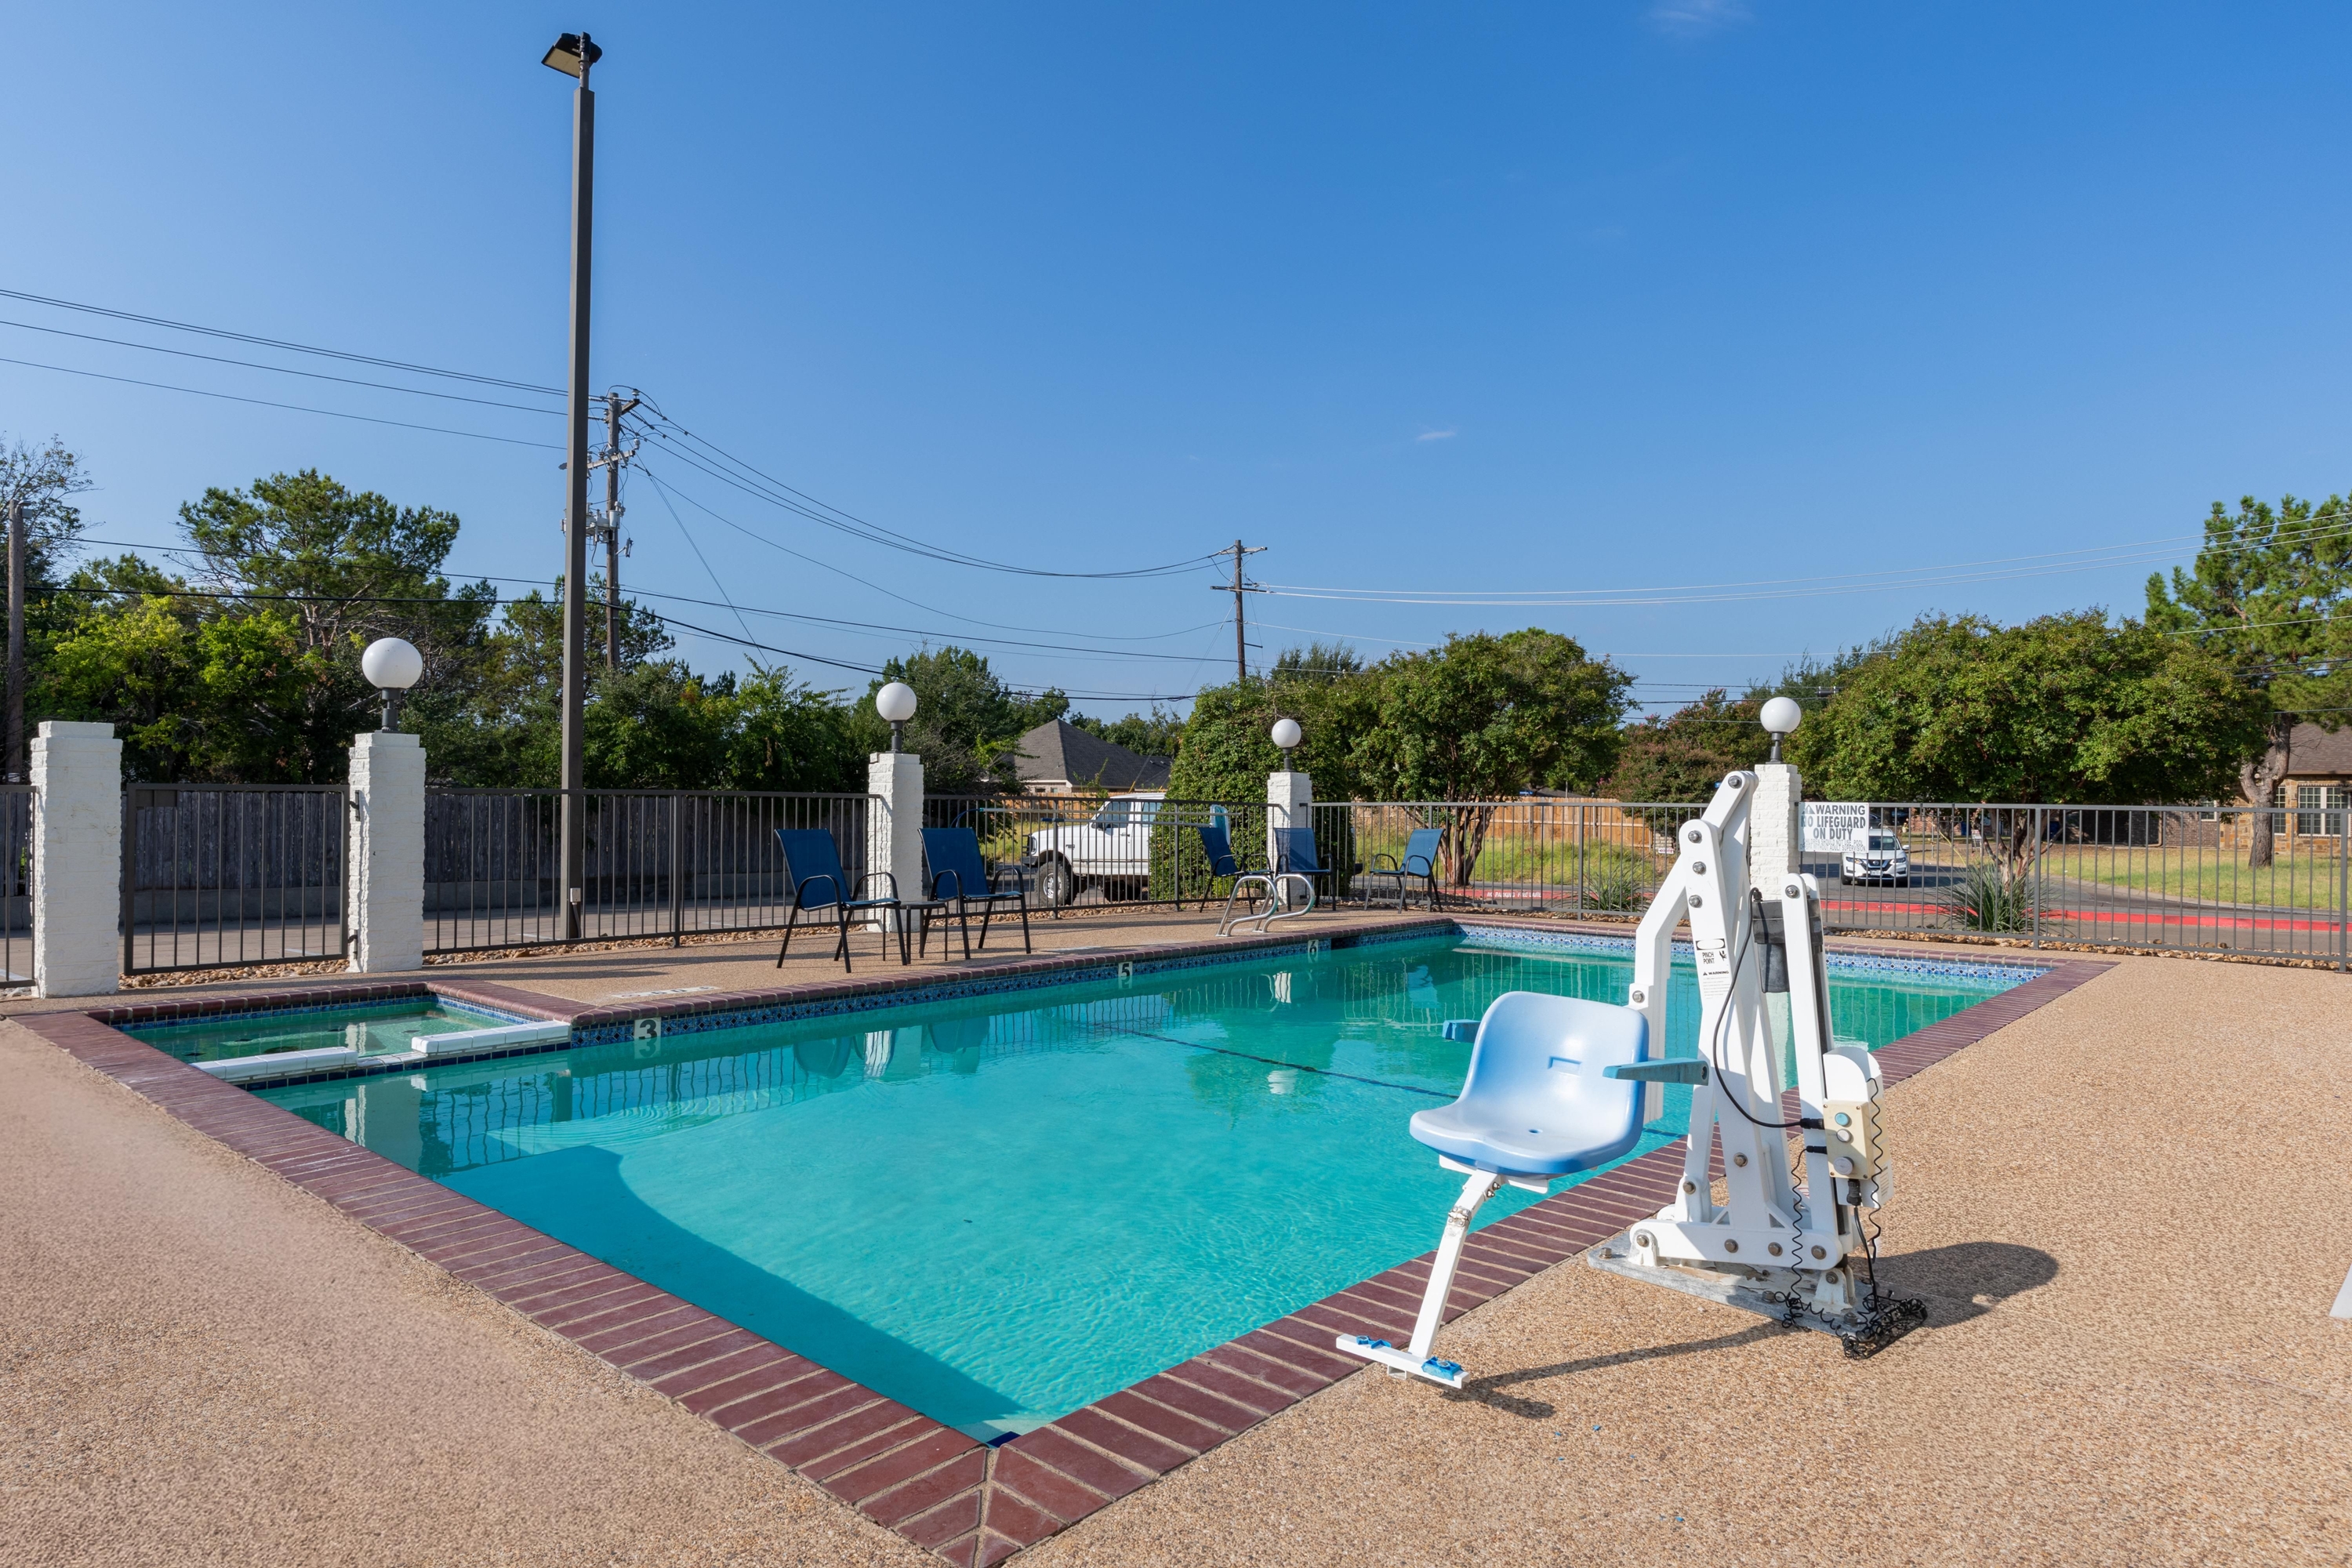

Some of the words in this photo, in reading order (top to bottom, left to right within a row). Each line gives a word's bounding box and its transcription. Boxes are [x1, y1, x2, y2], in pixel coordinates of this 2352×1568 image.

[1816, 804, 1865, 815] WARNING
[1801, 815, 1813, 827] NO
[1817, 816, 1866, 829] LIFEGUARD
[1813, 828, 1826, 840] ON
[1829, 828, 1853, 840] DUTY
[1121, 963, 1130, 978] 5
[638, 1019, 658, 1040] 3
